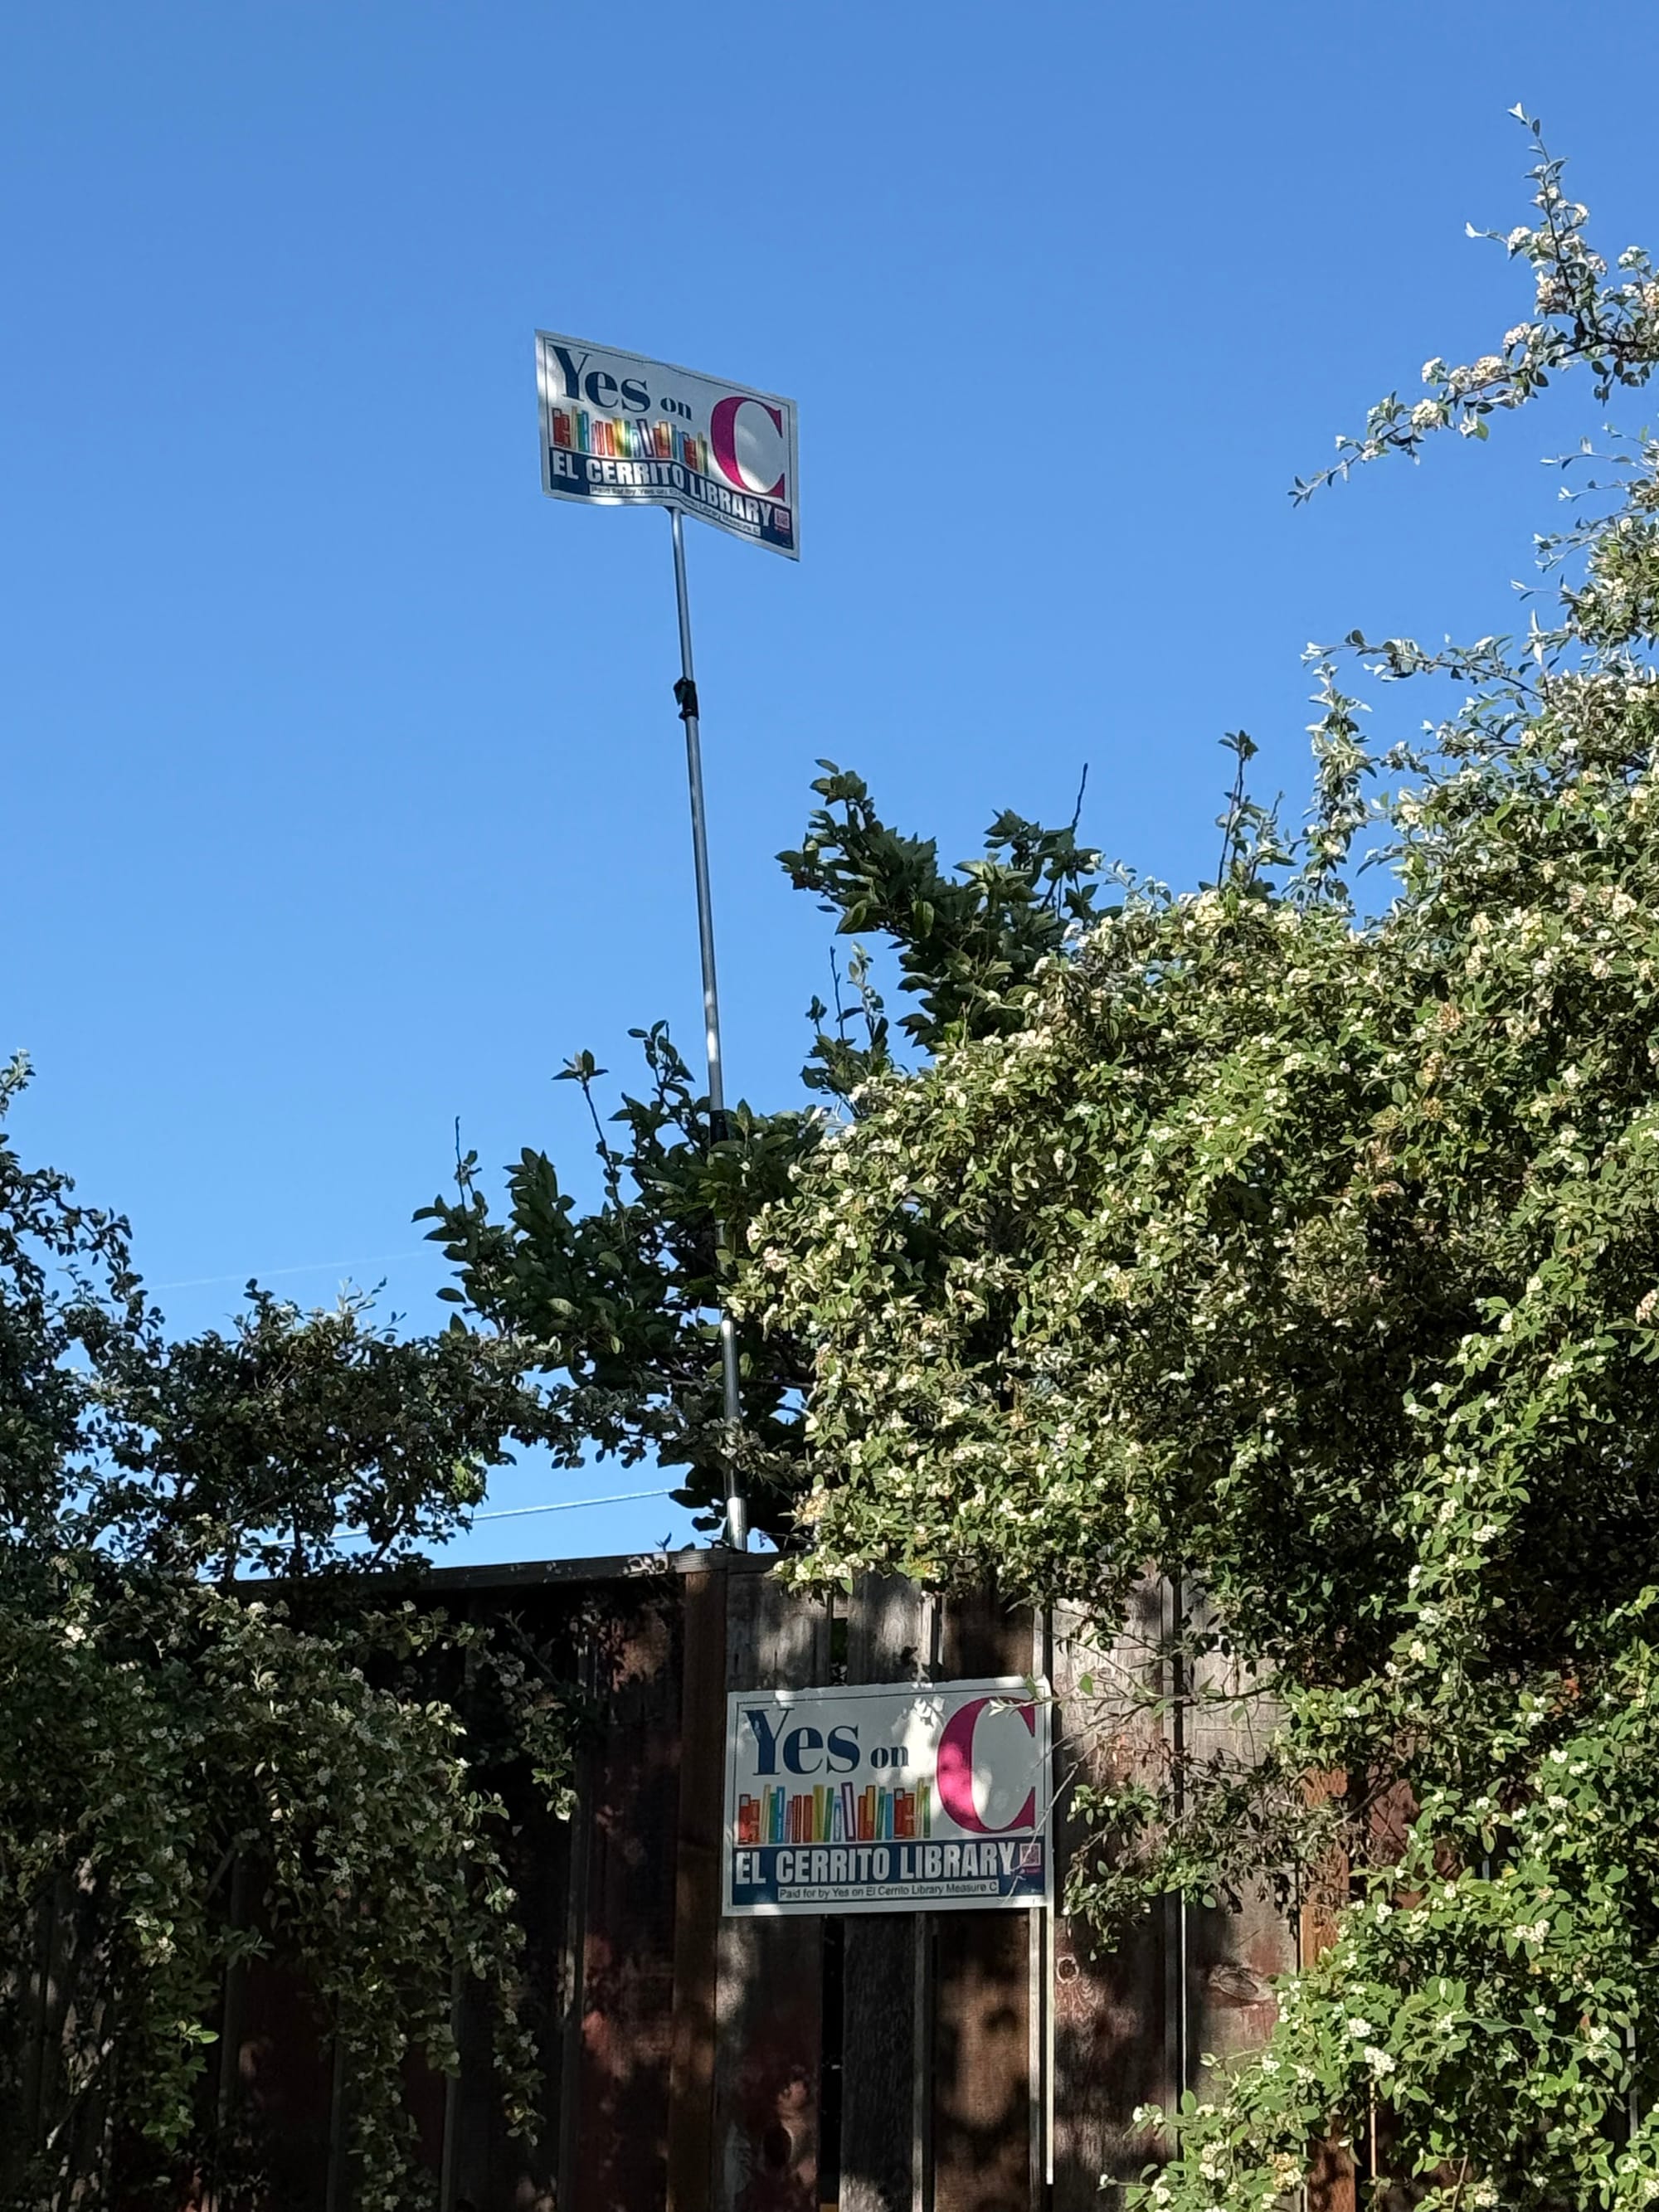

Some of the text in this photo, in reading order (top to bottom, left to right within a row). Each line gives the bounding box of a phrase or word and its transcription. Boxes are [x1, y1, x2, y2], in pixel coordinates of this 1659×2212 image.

[548, 345, 784, 501] Yes on C
[552, 451, 579, 480] EL
[586, 458, 684, 489] CERRITO
[689, 474, 771, 527] LIBRARY
[743, 1696, 1036, 1834] Yes on C
[736, 1841, 1016, 1885] EL CERRITO LIBRARY
[780, 1881, 997, 1899] Paid for by Yes on El Cerrito Library Measure C
